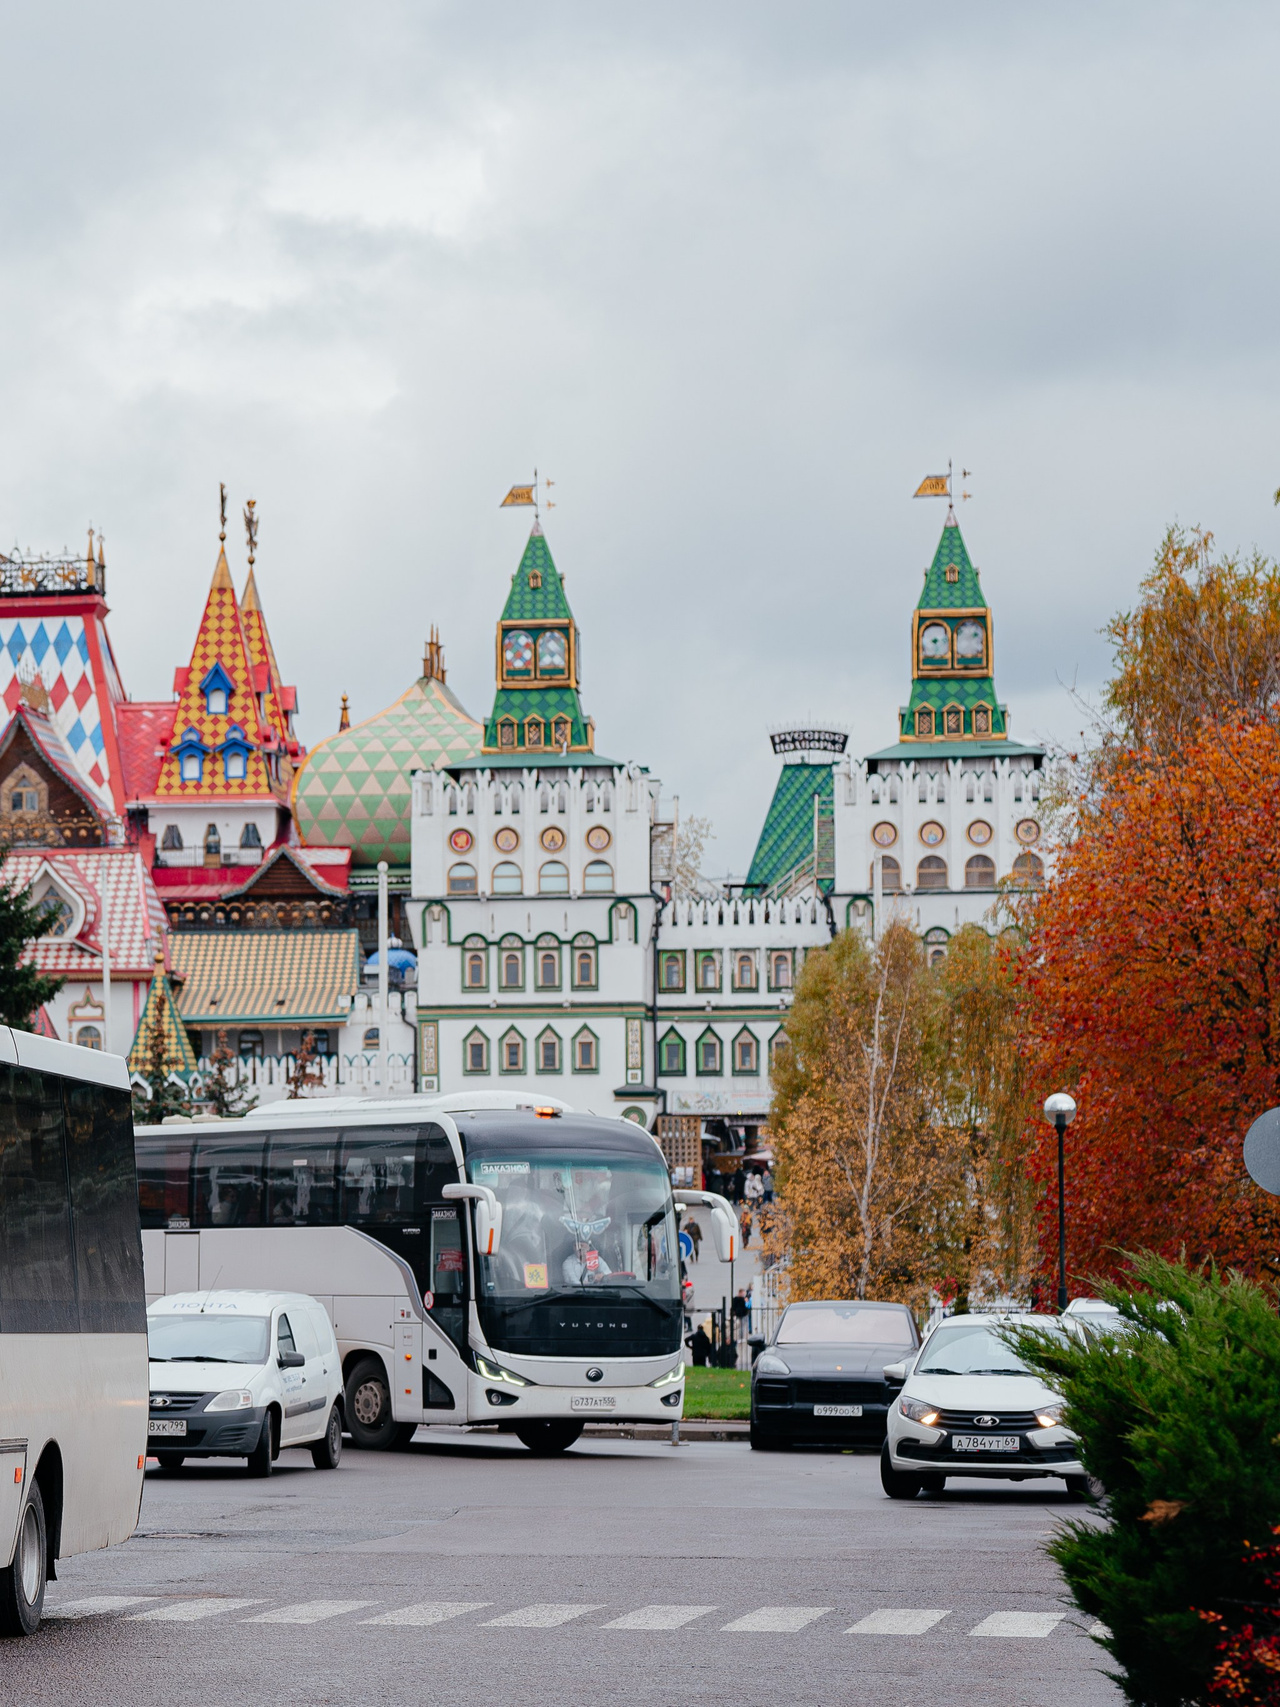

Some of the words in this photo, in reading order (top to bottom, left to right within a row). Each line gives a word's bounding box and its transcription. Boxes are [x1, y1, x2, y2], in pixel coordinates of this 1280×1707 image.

[774, 731, 845, 744] РУССКОЕ
[482, 1164, 529, 1173] ЗАКАЗНОЙ
[1004, 1437, 1016, 1447] 69
